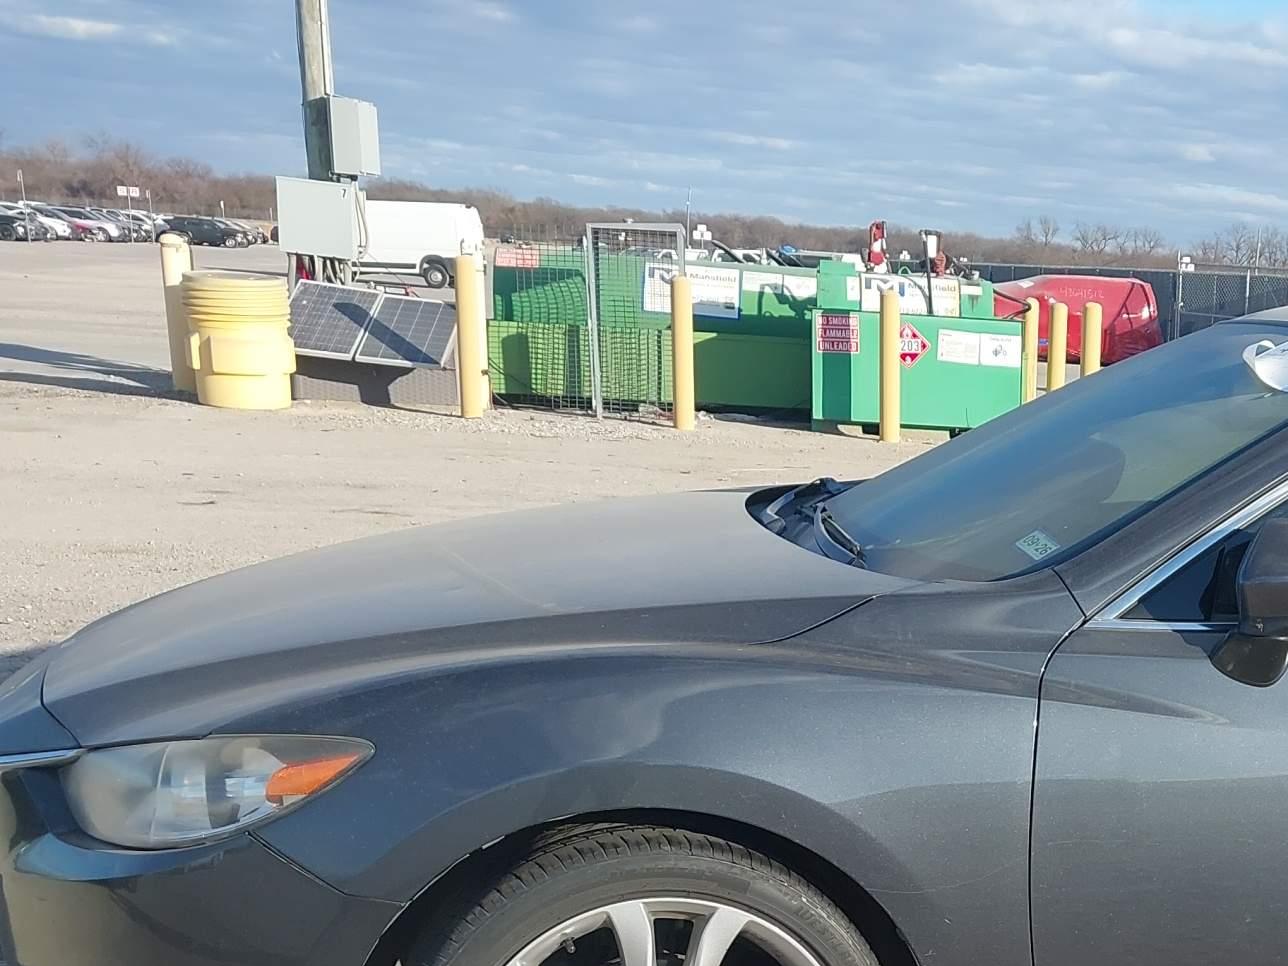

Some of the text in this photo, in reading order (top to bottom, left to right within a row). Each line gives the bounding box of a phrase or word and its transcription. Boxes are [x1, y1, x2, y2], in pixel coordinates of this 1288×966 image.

[819, 328, 857, 338] FLAMMABLE
[820, 341, 857, 351] UNLEADED
[900, 340, 920, 351] 203
